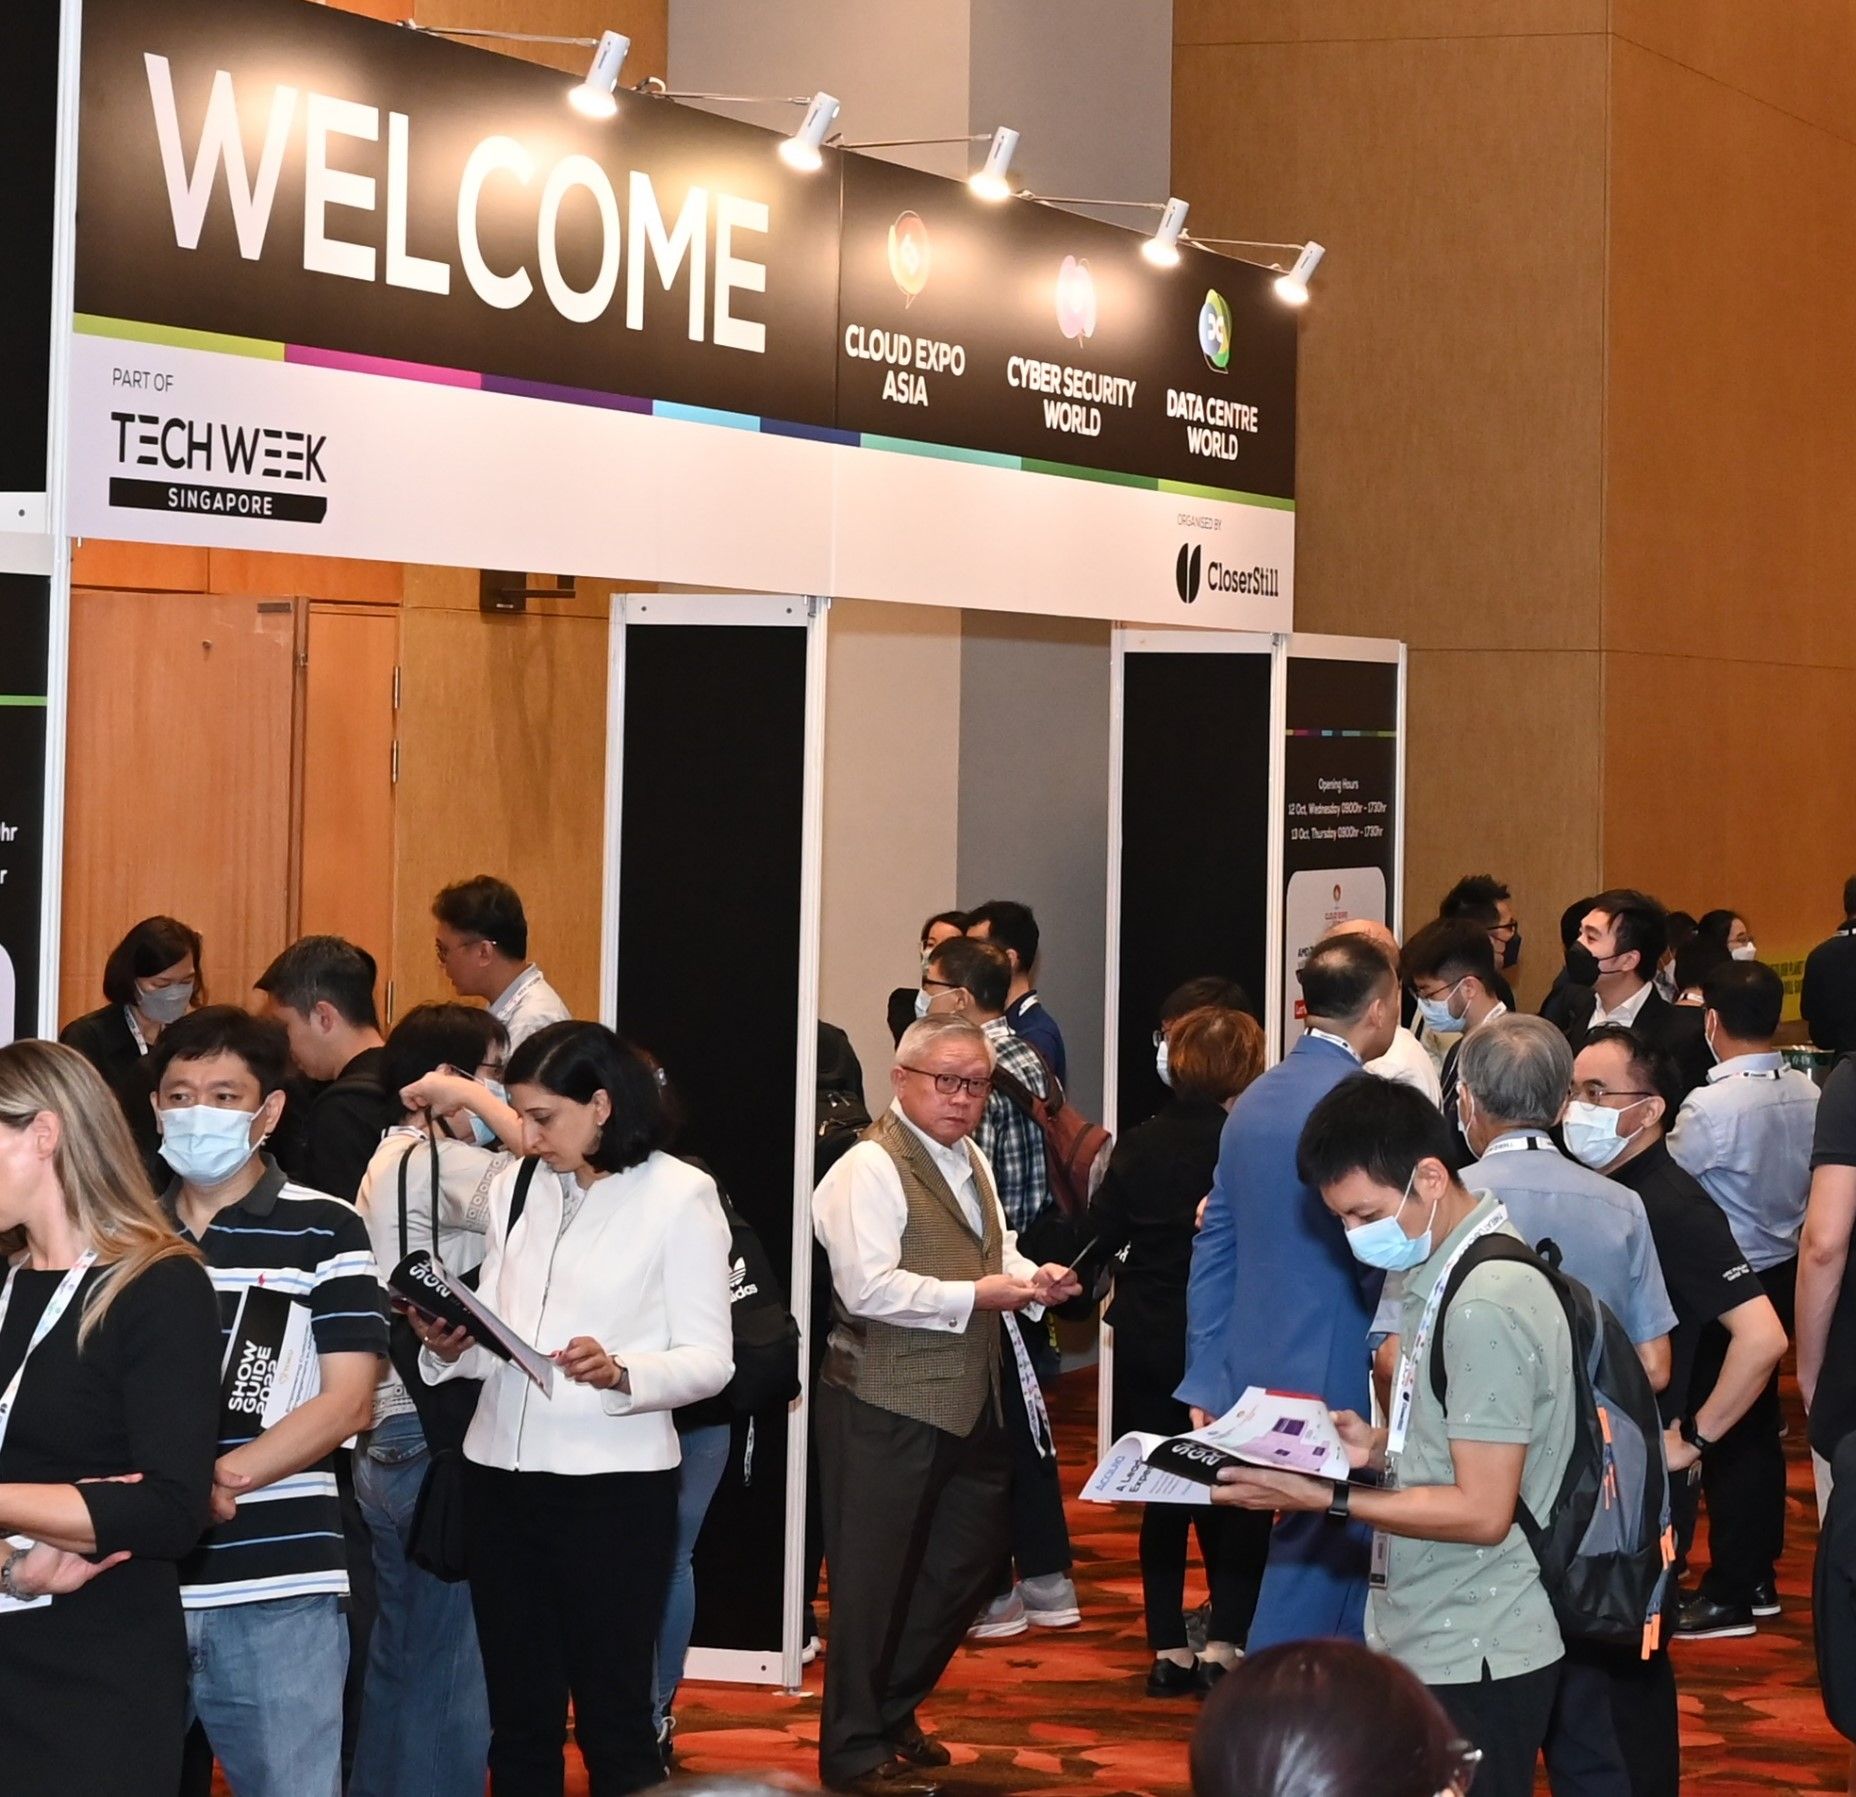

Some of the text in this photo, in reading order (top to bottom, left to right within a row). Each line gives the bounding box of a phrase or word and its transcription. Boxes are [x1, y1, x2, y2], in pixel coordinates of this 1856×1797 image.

[144, 52, 769, 354] WELCOME
[845, 324, 966, 376] CLOUD EXPO
[112, 368, 174, 392] PART OF
[882, 370, 928, 407] ASIA
[1007, 356, 1137, 408] CYBER SECURITY
[1043, 399, 1101, 436] WORLD
[1166, 388, 1258, 433] DATA CENTRE
[111, 411, 327, 483] TECH WEEK
[1187, 425, 1238, 461] WORLD
[168, 488, 273, 515] SINGAPORE
[1176, 513, 1222, 530] ORGANISED BY
[1207, 561, 1279, 597] CloserStill
[228, 1339, 257, 1411] SHOW
[243, 1345, 272, 1413] GUIDE
